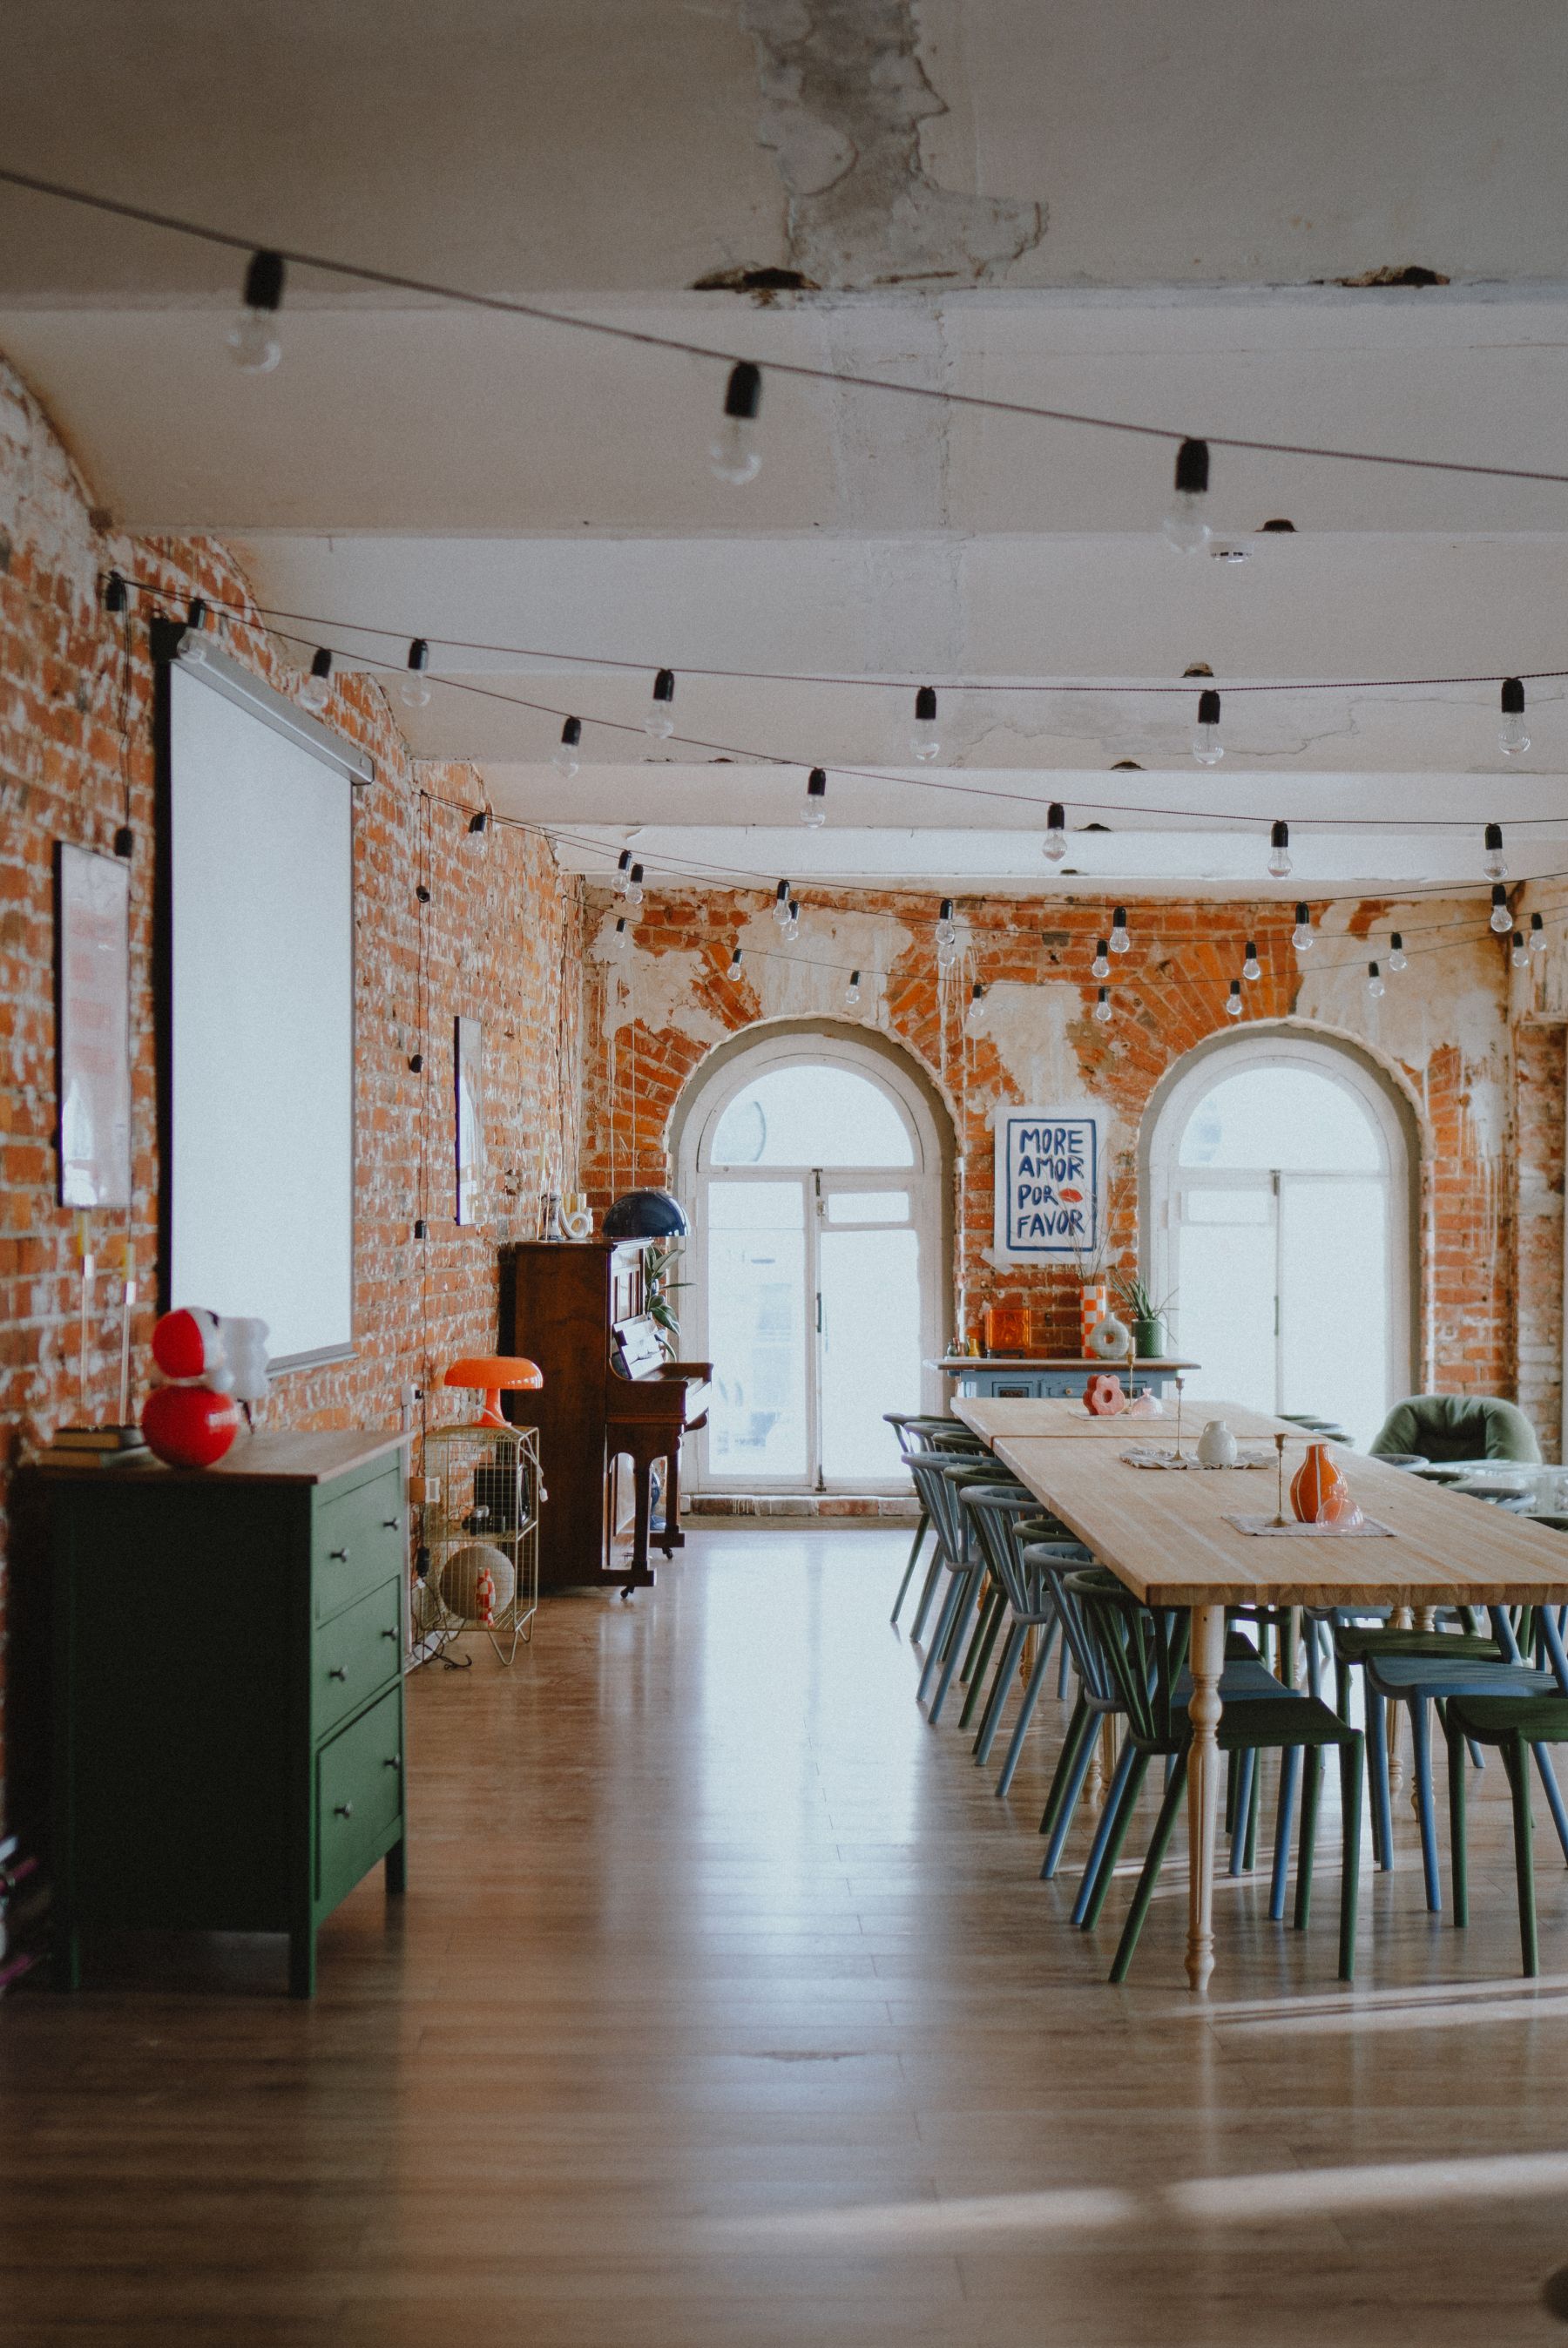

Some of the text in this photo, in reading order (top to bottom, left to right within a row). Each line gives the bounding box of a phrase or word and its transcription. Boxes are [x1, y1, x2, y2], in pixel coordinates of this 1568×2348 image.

[1019, 1128, 1084, 1155] MORE
[1018, 1155, 1085, 1182] AMOR
[1017, 1184, 1059, 1209] POR
[1017, 1209, 1085, 1239] FAVOR
